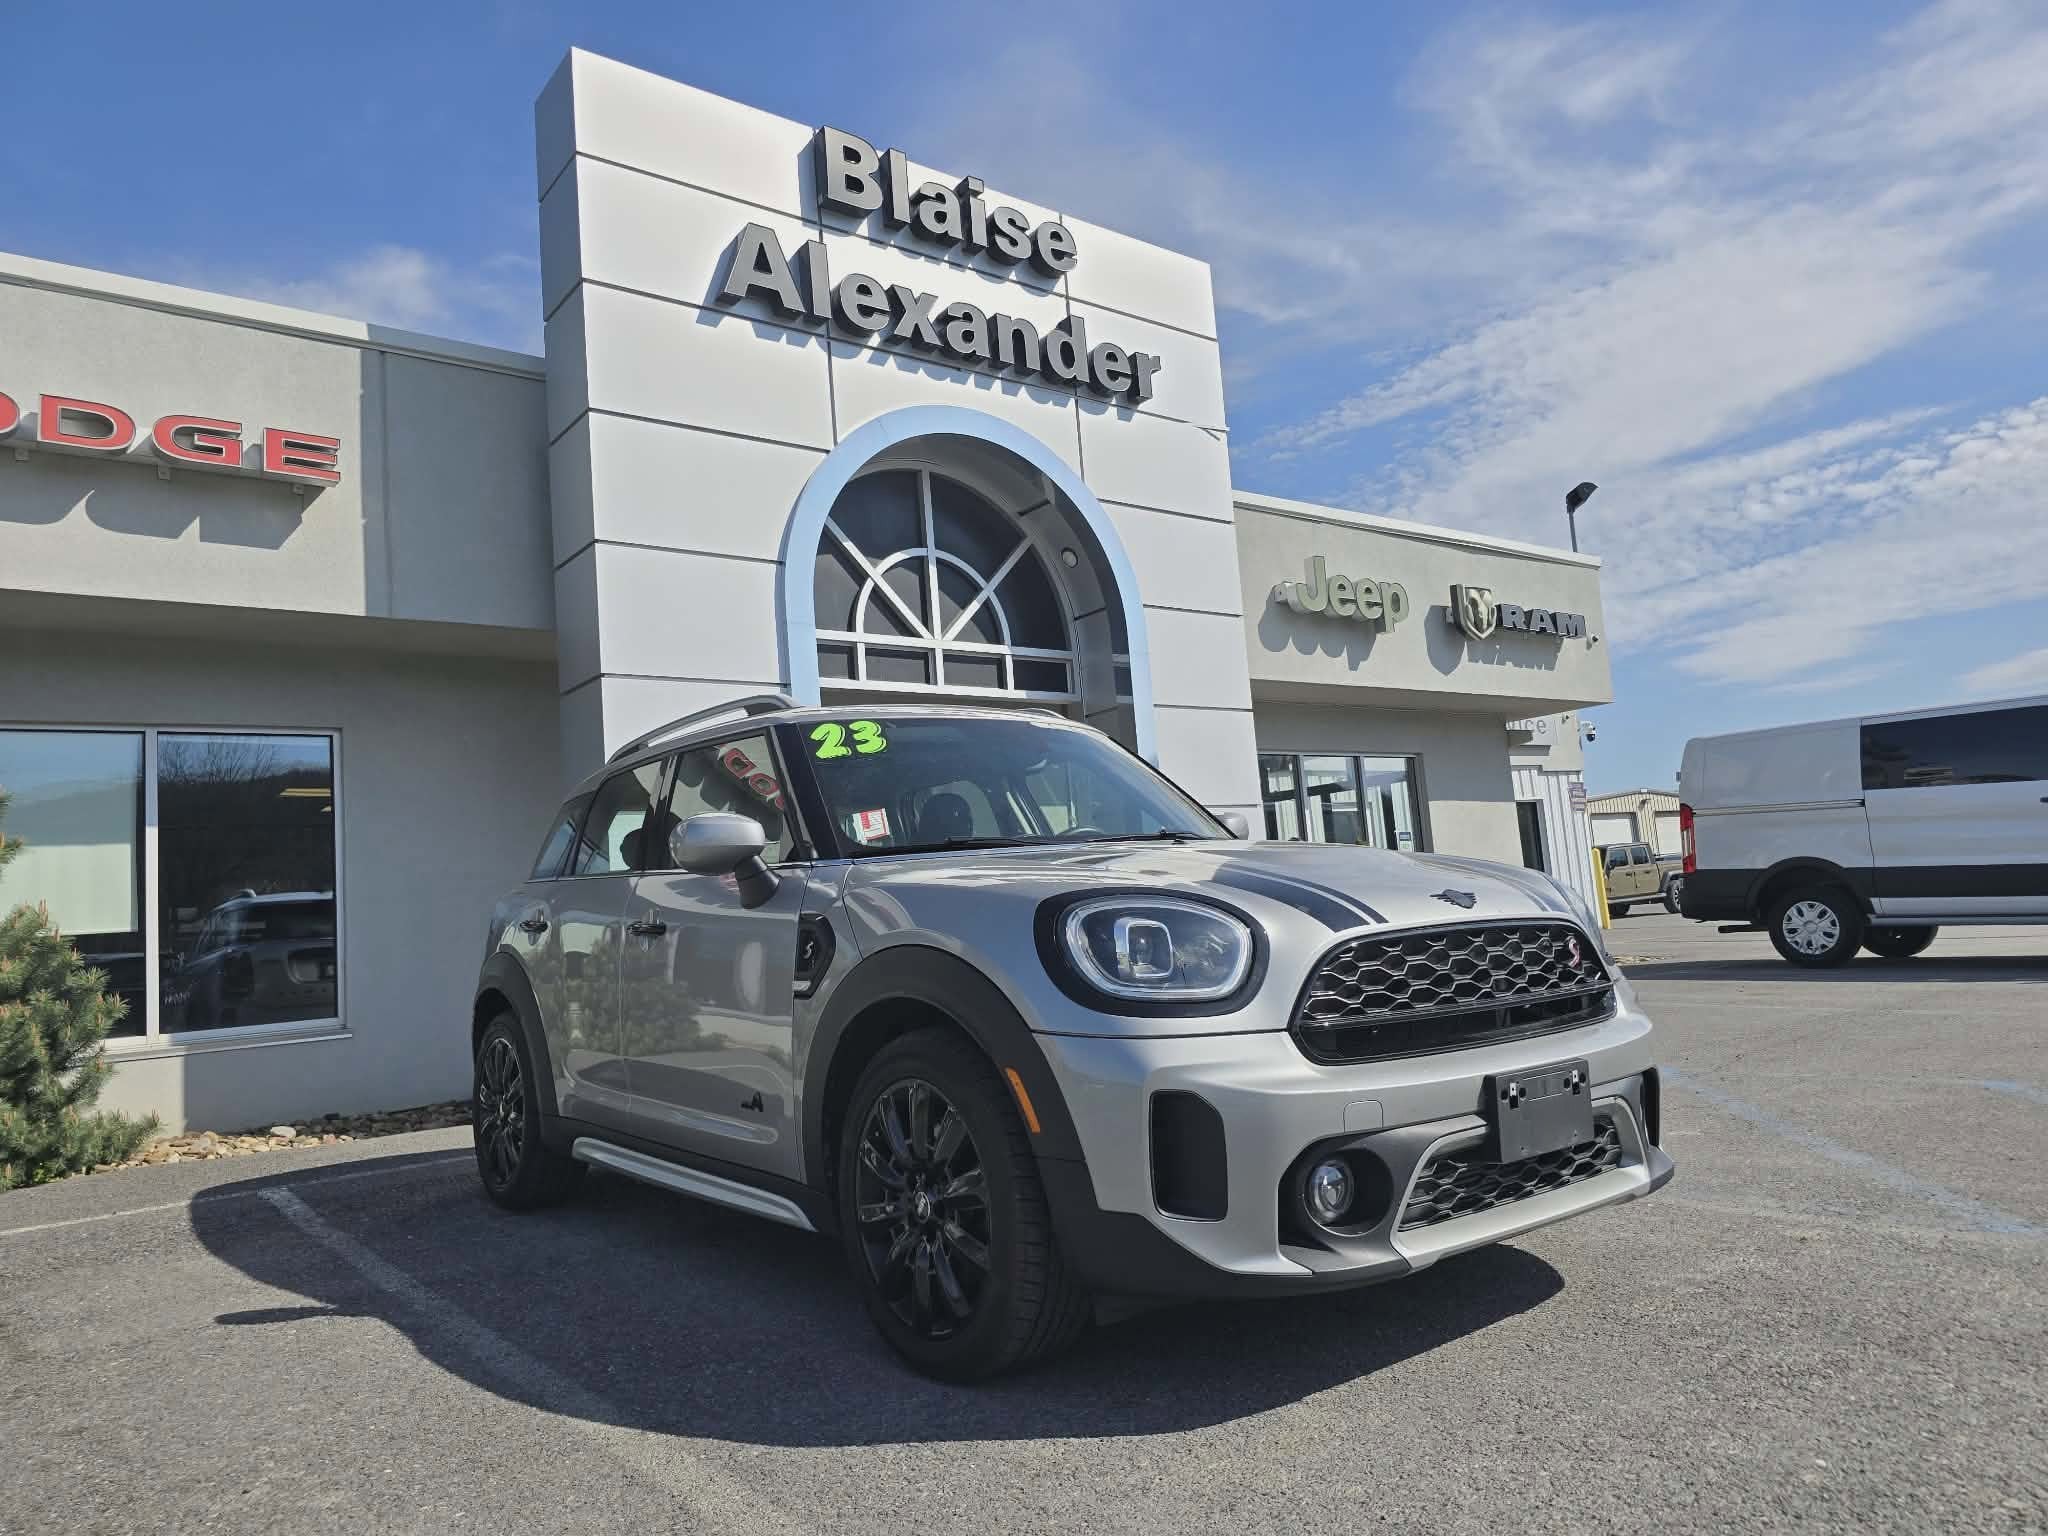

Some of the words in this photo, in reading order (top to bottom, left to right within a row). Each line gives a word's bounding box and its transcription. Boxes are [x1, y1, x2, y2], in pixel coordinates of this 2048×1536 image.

[816, 125, 1078, 277] Blaise
[718, 222, 1162, 401] Alexander
[0, 391, 342, 485] DGE
[1293, 555, 1410, 633] Jeep
[1498, 603, 1587, 638] RAM
[809, 720, 888, 760] 23
